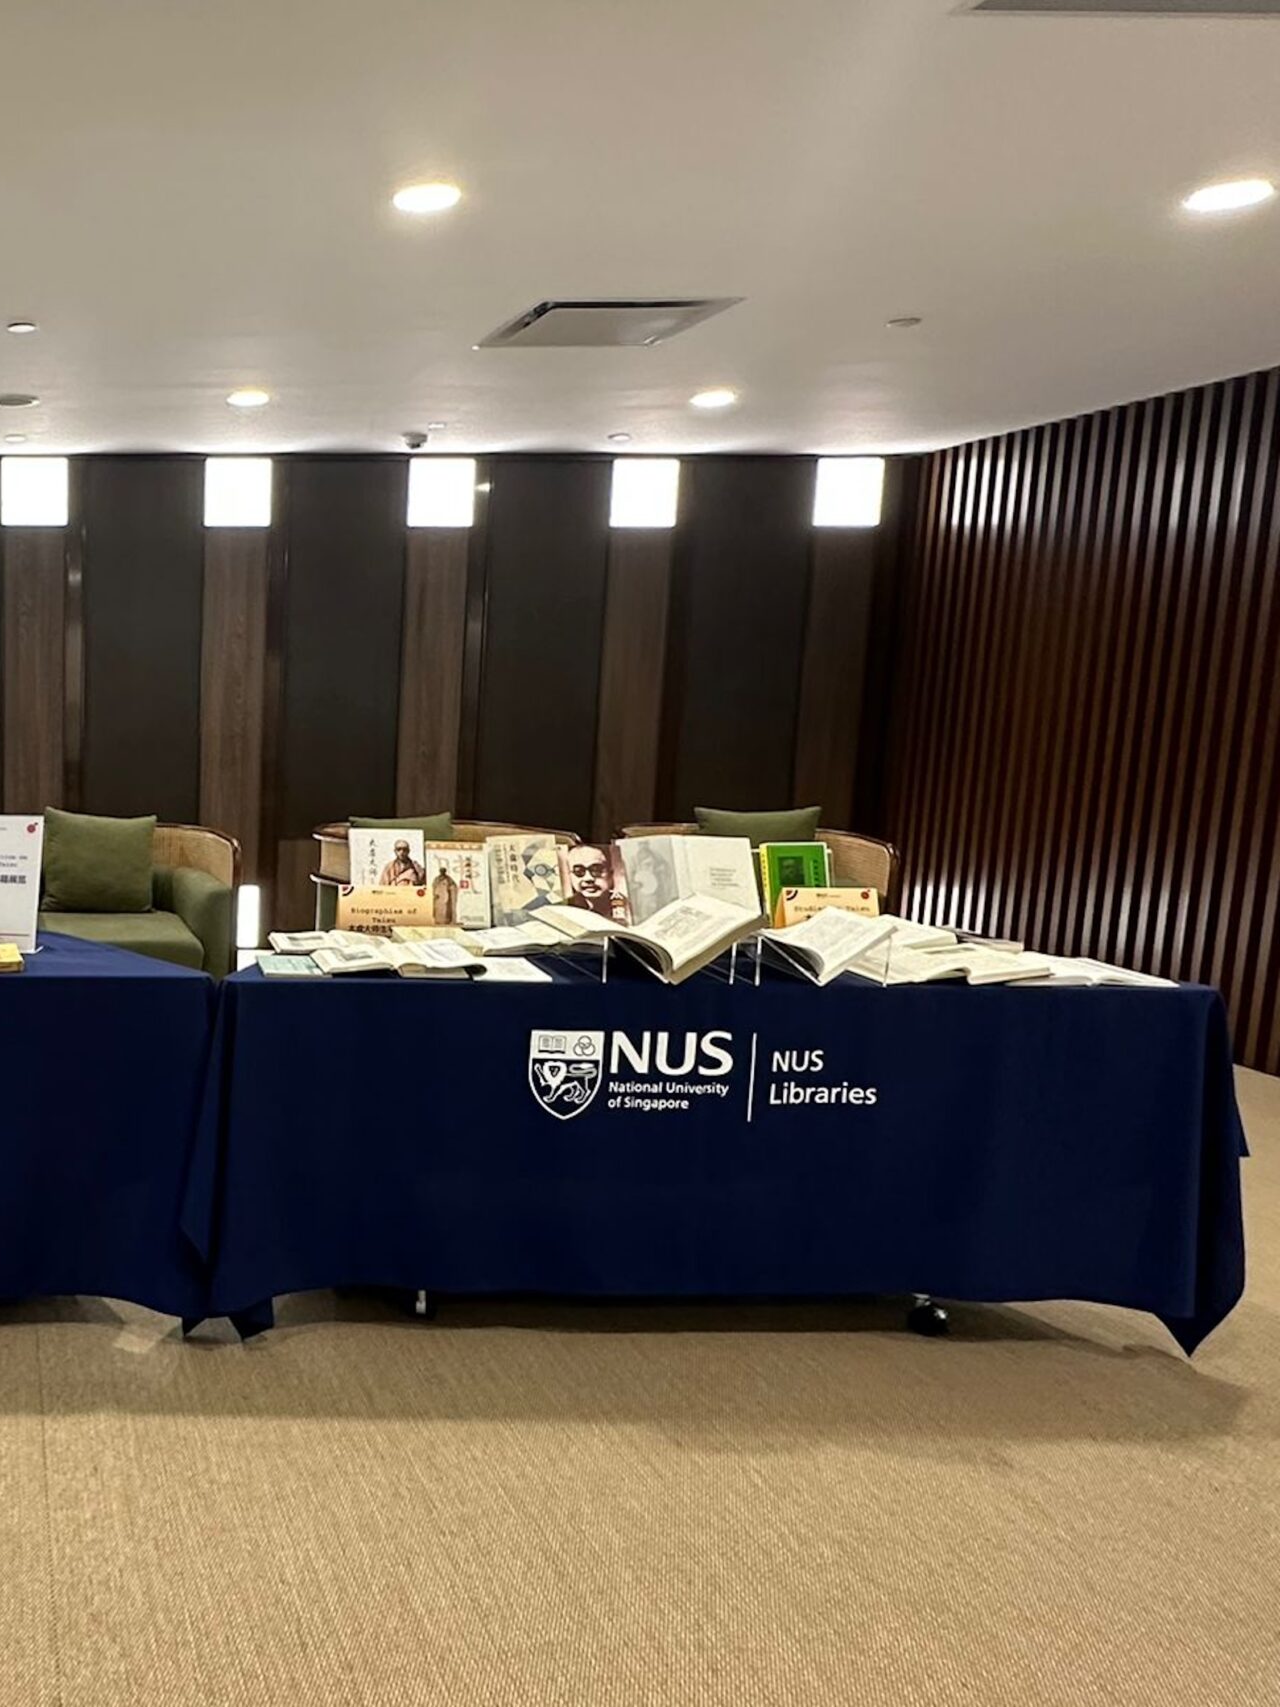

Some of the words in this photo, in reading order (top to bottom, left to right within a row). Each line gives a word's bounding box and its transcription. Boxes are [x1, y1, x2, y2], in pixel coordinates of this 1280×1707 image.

[609, 1030, 734, 1076] NUS
[771, 1050, 824, 1072] NUS
[608, 1080, 664, 1094] National
[666, 1081, 730, 1097] University
[769, 1081, 877, 1105] Libraries
[608, 1096, 622, 1109] of
[624, 1096, 689, 1111] Singapore
